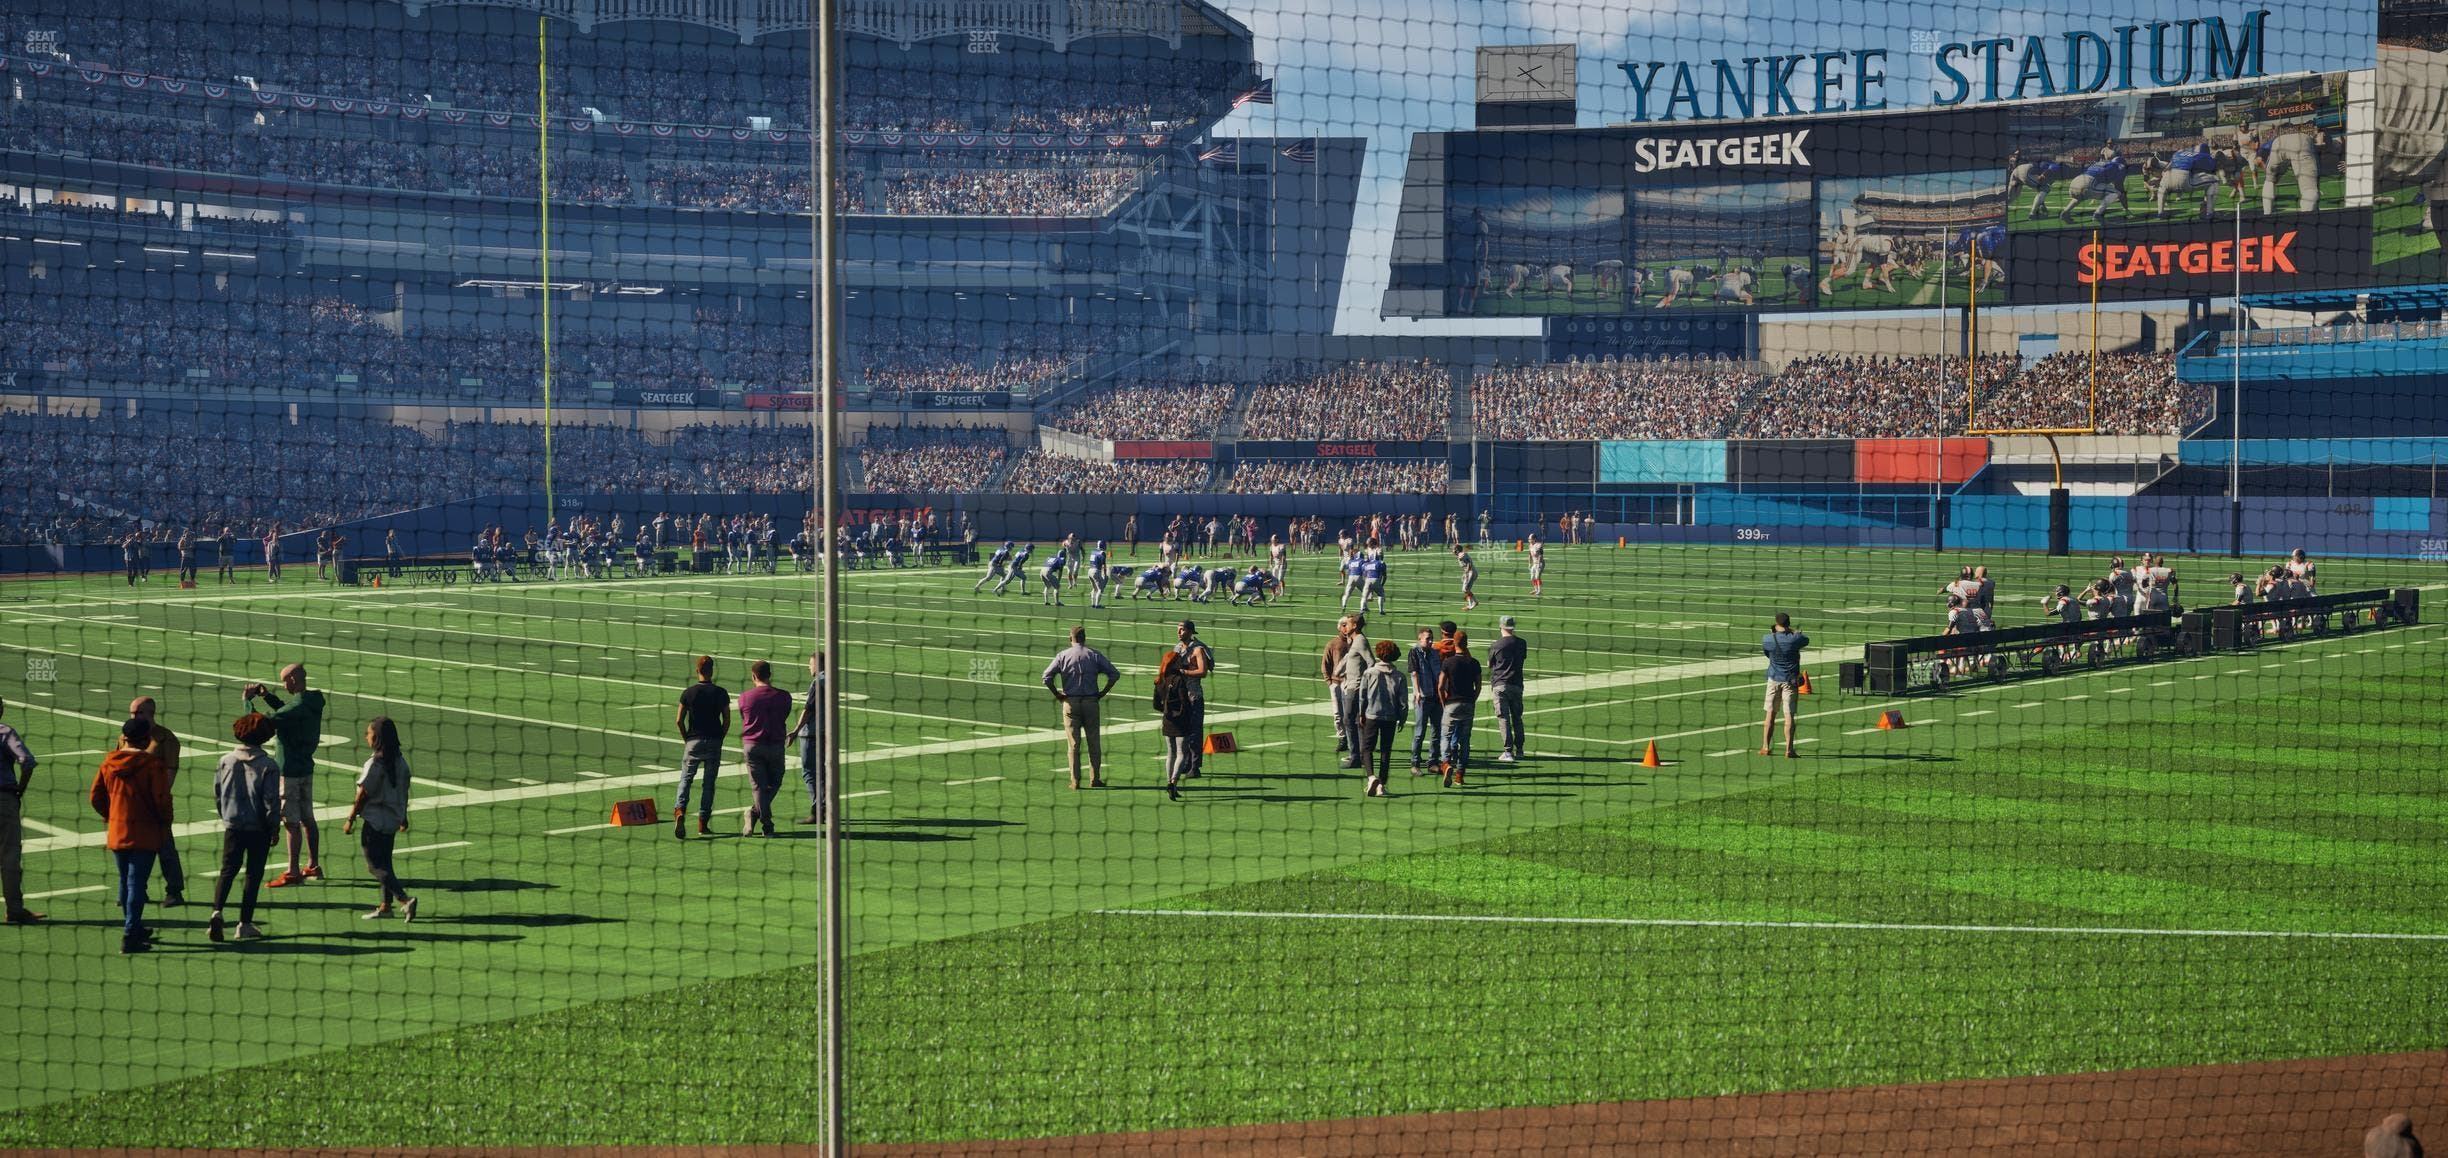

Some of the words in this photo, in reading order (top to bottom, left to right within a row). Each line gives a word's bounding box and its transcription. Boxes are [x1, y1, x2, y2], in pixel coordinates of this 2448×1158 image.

[1617, 48, 1887, 122] YANKEE
[1934, 9, 2271, 106] STADIUM
[2267, 101, 2314, 117] SEATGEEK
[1634, 128, 1811, 173] SEATGEEK
[2077, 230, 2299, 284] SEATGEEK
[640, 391, 695, 405] SEATGEEK
[769, 396, 823, 407] SEATGEE
[935, 394, 986, 406] SEATGEEK
[1317, 442, 1376, 457] SEATGEEK
